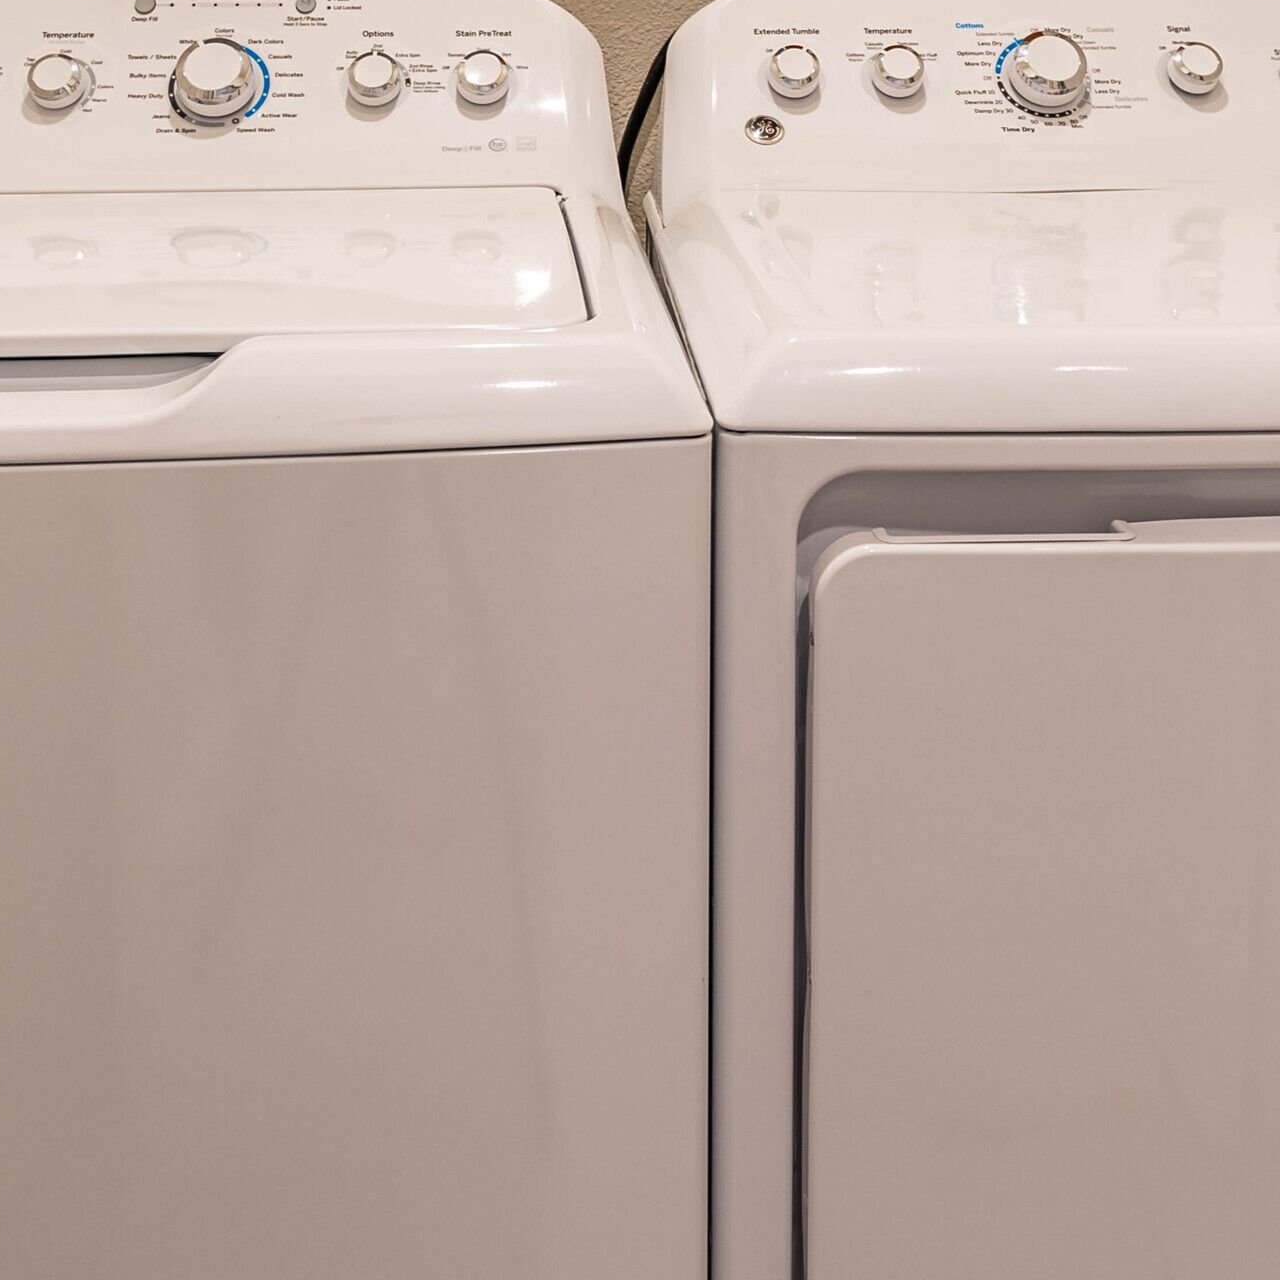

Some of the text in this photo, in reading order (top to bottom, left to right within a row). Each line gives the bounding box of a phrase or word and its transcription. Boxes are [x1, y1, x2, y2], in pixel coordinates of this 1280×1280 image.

[362, 30, 395, 39] Options
[455, 30, 477, 38] Stain
[863, 27, 913, 35] Temperature
[42, 31, 95, 40] Temperature
